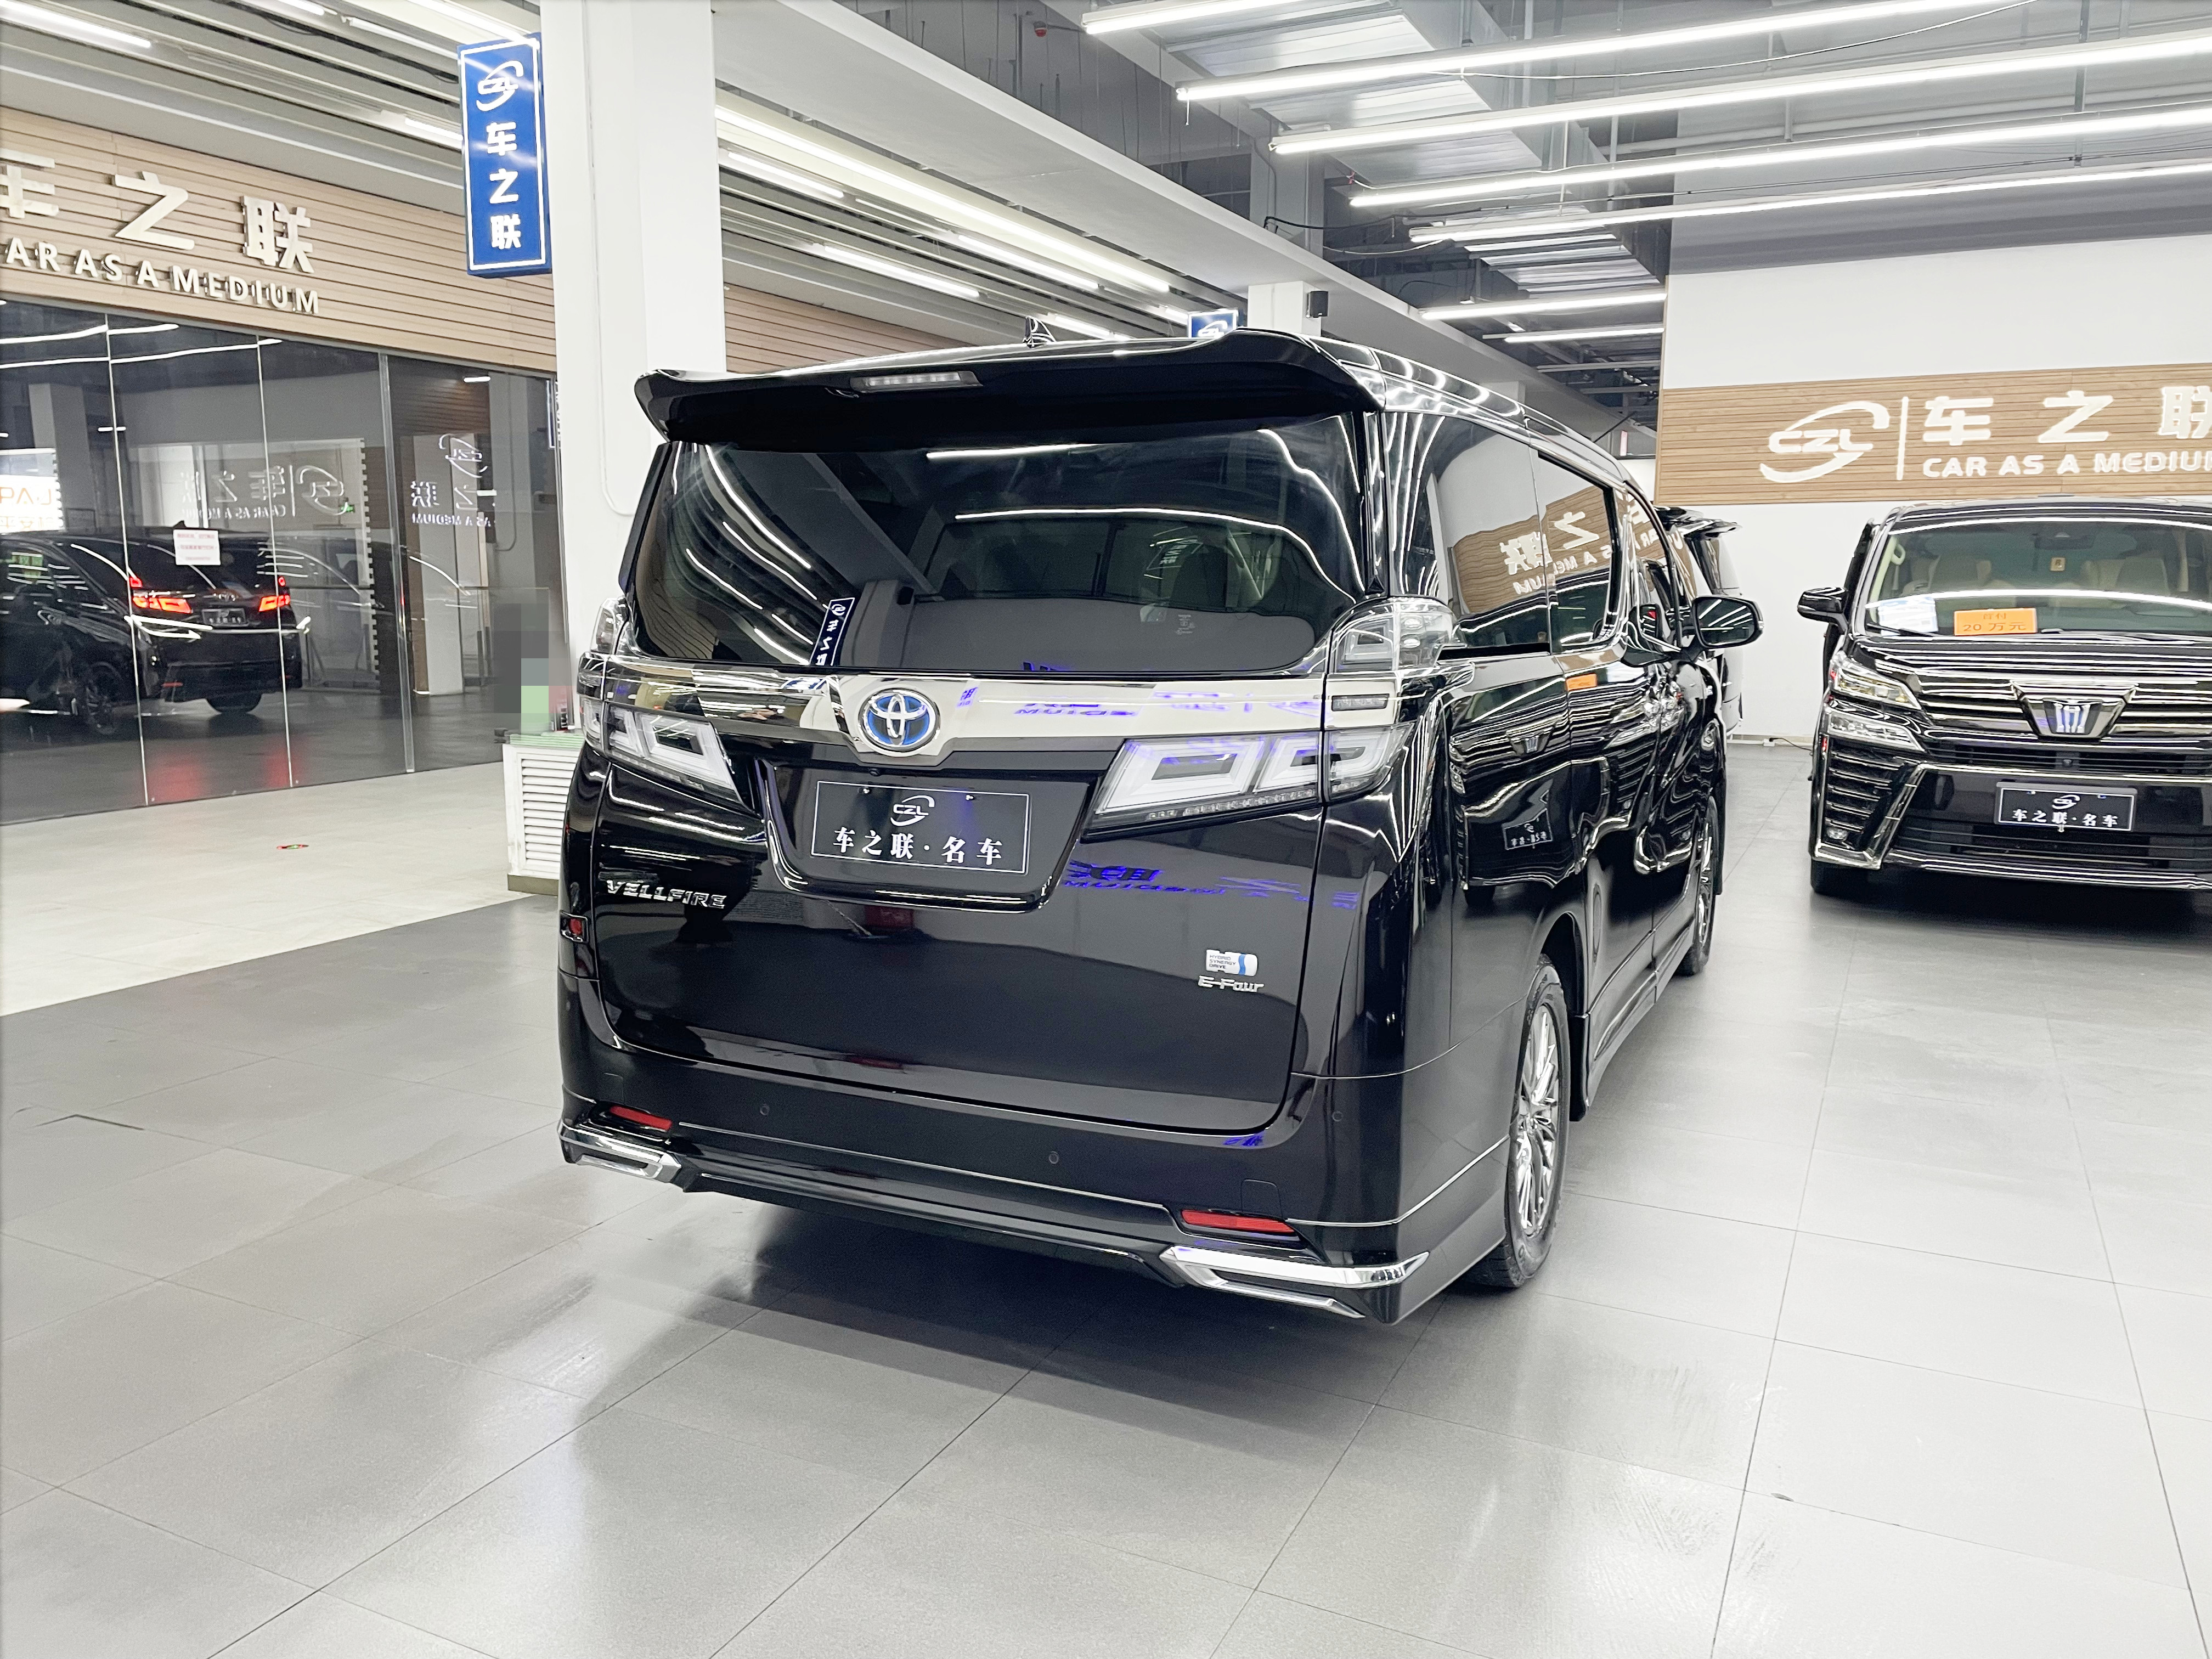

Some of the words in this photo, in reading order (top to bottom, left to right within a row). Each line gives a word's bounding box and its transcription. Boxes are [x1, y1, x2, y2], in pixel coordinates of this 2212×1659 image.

[486, 122, 521, 250] 车之联
[0, 148, 314, 273] 车之联
[137, 259, 159, 287] A
[171, 266, 319, 314] MEDIUM
[1923, 385, 2212, 445] 车之联
[1923, 456, 1987, 478] CAR
[1999, 454, 2044, 476] AS
[2057, 453, 2080, 474] A
[2094, 450, 2212, 473] MEDIU
[833, 826, 1003, 865] 车之联·名车
[606, 879, 727, 909] VELLFIRE
[1198, 975, 1265, 993] E-Four
